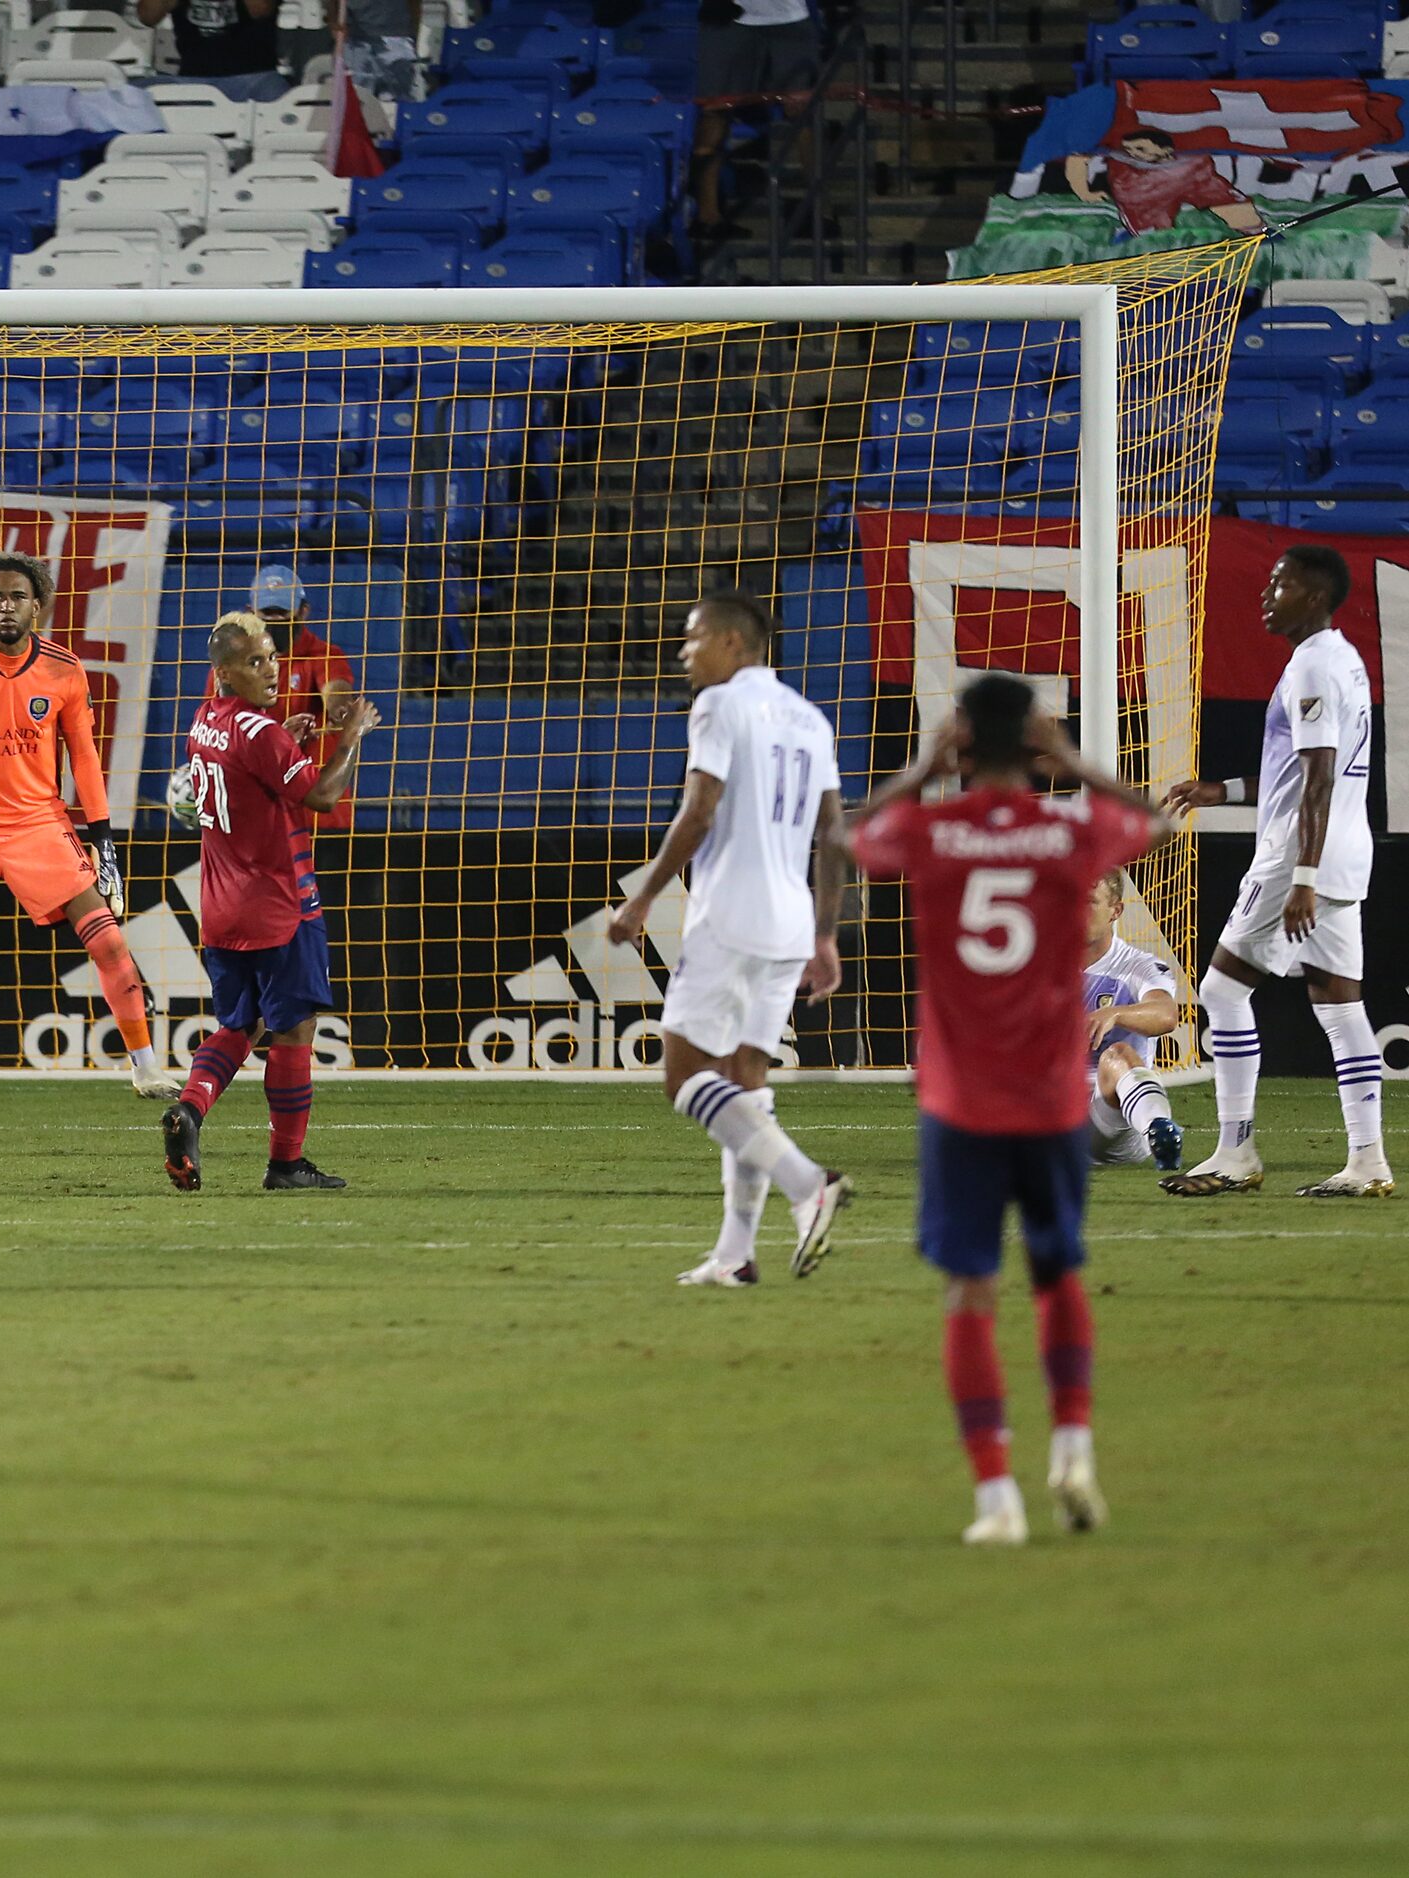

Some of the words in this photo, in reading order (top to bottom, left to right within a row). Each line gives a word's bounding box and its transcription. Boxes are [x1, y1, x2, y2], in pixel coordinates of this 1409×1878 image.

[191, 753, 231, 834] 21
[771, 744, 811, 826] 11
[956, 867, 1037, 976] 5
